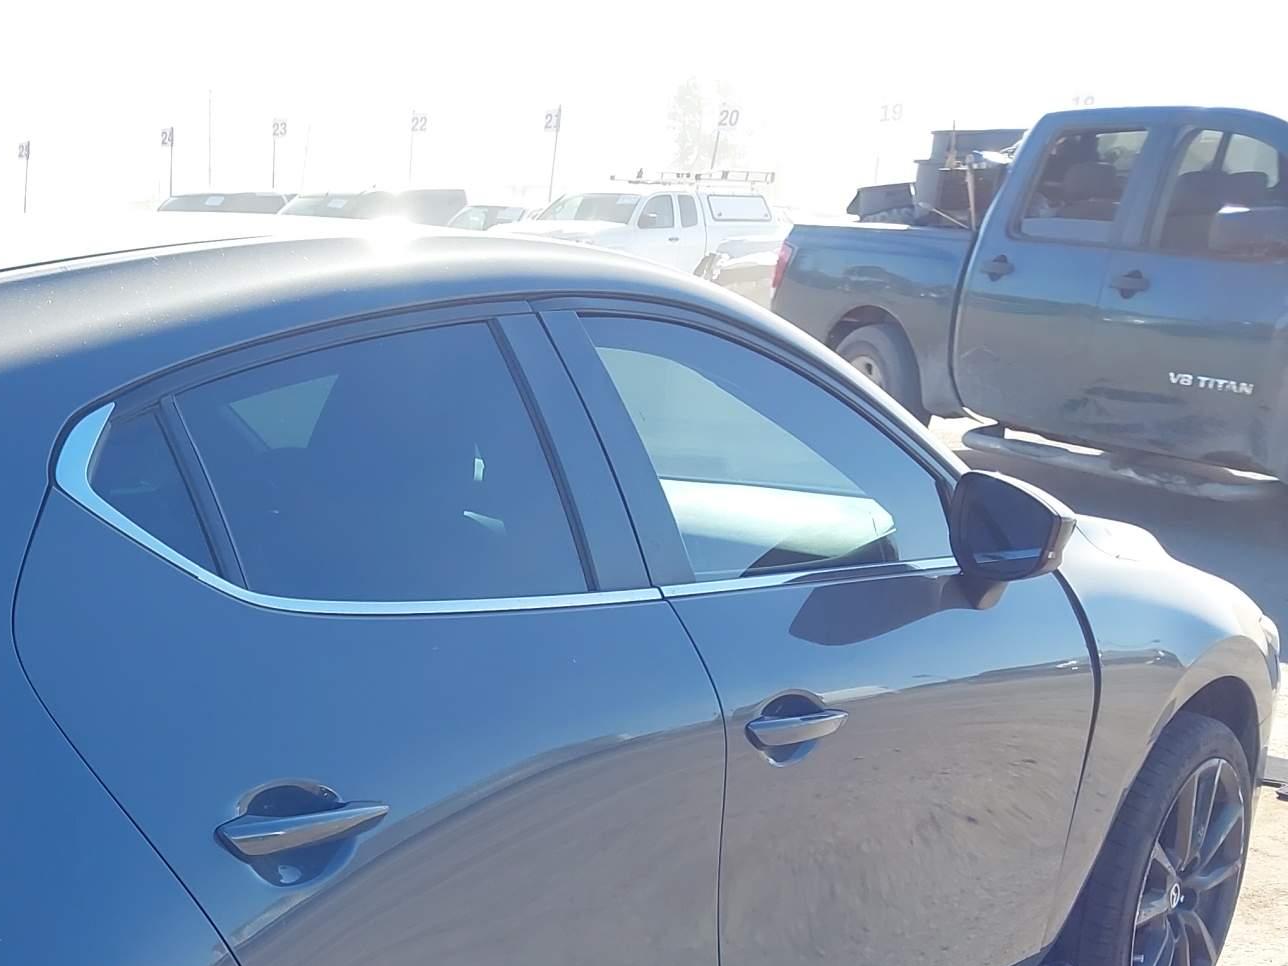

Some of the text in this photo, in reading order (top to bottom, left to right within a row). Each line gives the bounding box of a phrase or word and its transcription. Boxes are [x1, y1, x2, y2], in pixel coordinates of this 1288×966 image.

[544, 113, 560, 129] 21
[717, 109, 739, 127] 20
[879, 103, 903, 122] 19
[272, 122, 287, 137] 23
[411, 116, 427, 132] 22
[1168, 371, 1254, 395] V8 TITAN
